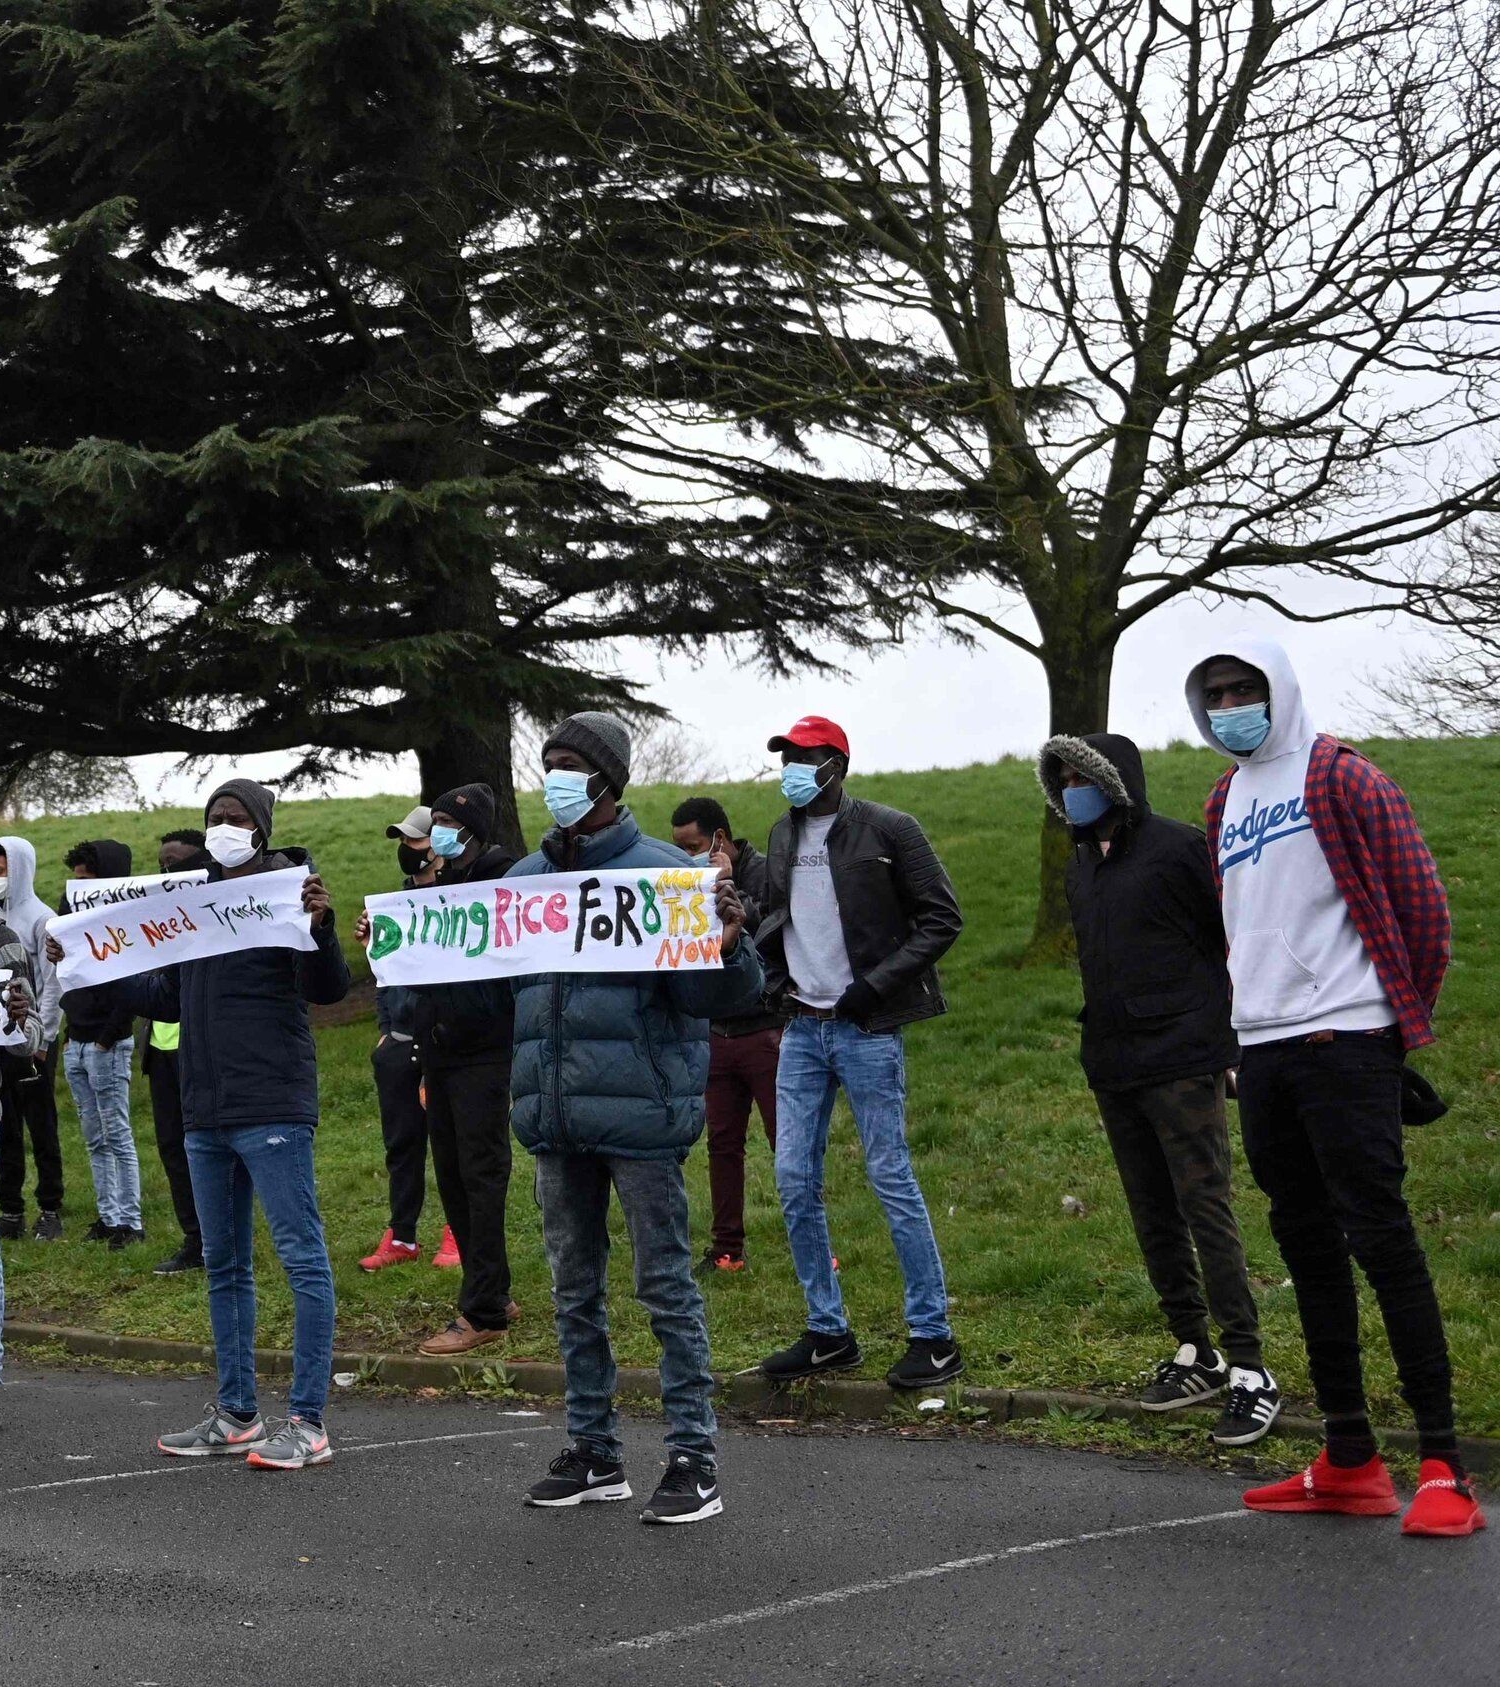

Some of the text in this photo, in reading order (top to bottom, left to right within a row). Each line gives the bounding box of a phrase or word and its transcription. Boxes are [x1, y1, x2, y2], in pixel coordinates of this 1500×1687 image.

[84, 925, 134, 961] We
[140, 906, 198, 947] Need
[369, 894, 489, 961] Dining
[494, 887, 568, 949] Rice
[637, 877, 662, 935] 8
